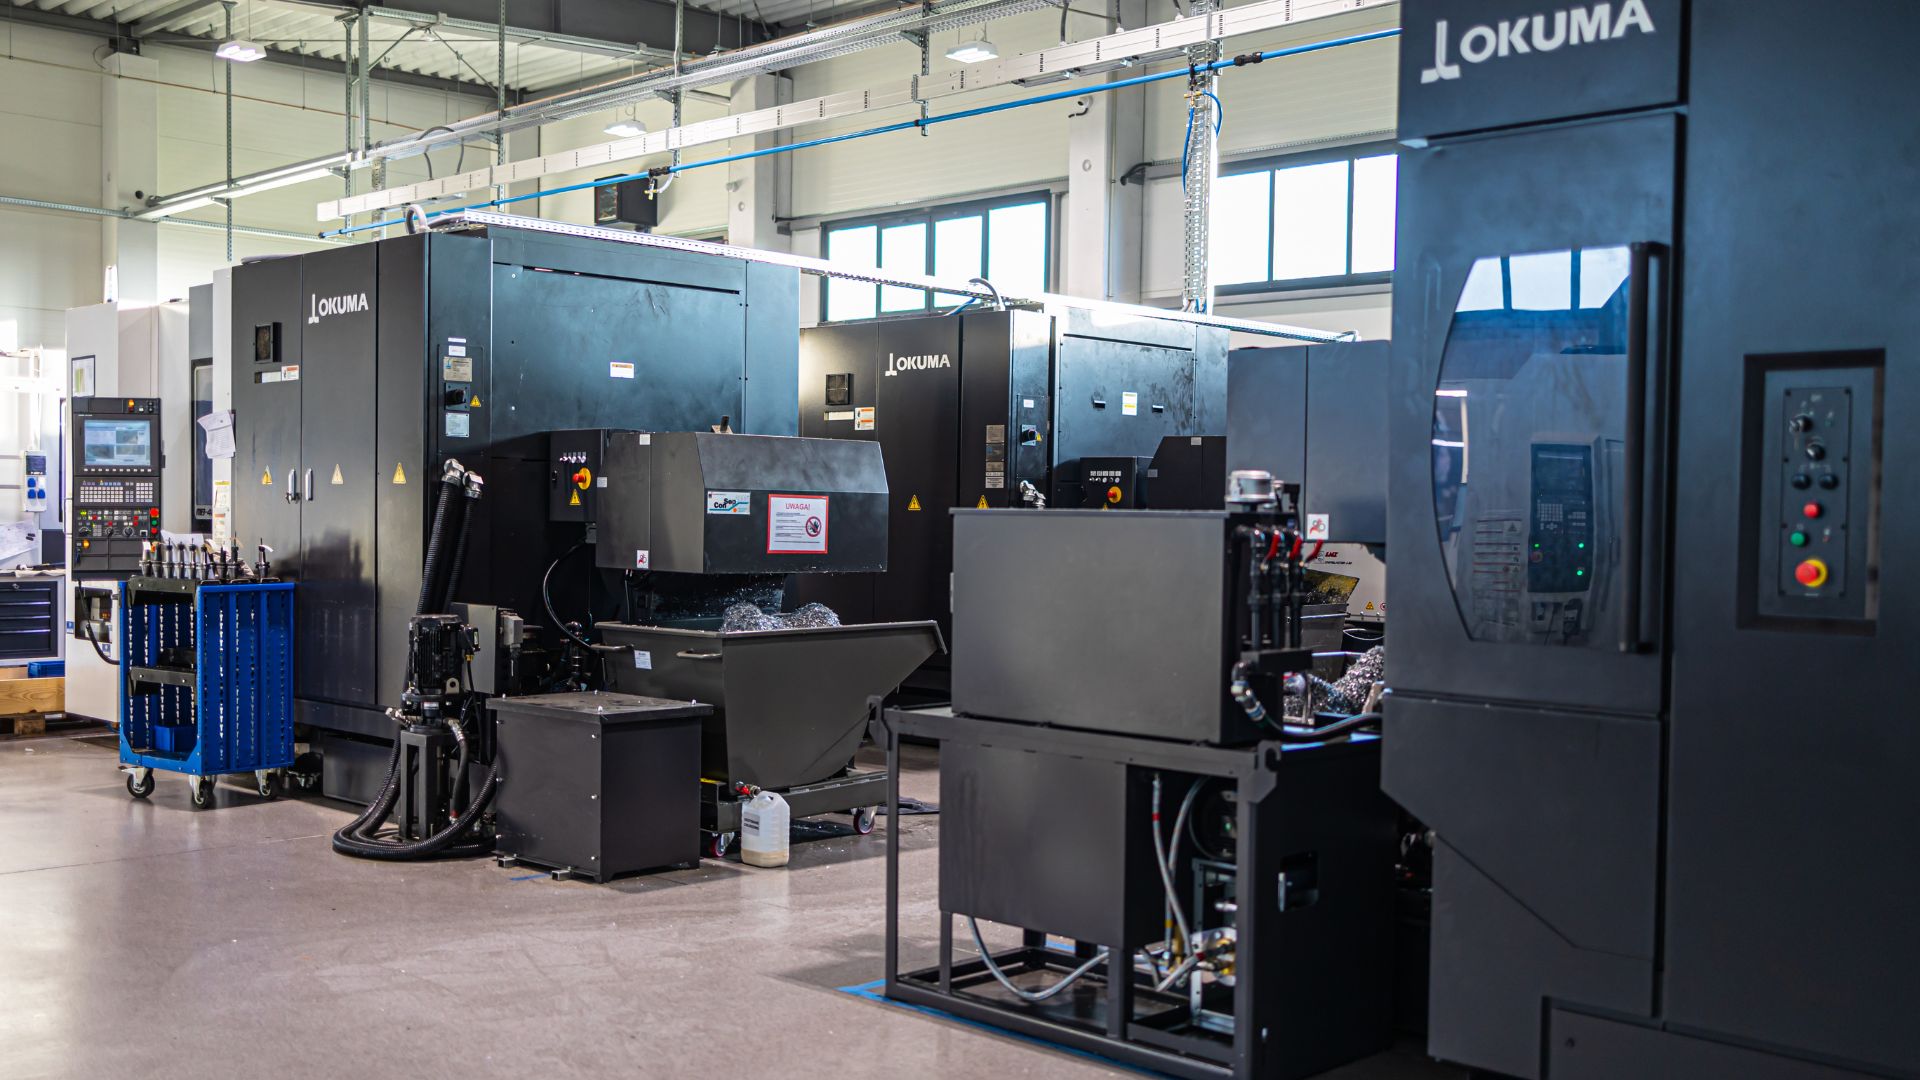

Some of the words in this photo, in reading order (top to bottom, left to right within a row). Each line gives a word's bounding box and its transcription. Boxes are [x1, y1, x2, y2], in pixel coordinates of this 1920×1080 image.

[1459, 0, 1656, 63] OKUMA
[318, 293, 369, 317] OKUMA
[896, 354, 951, 371] OKUMA
